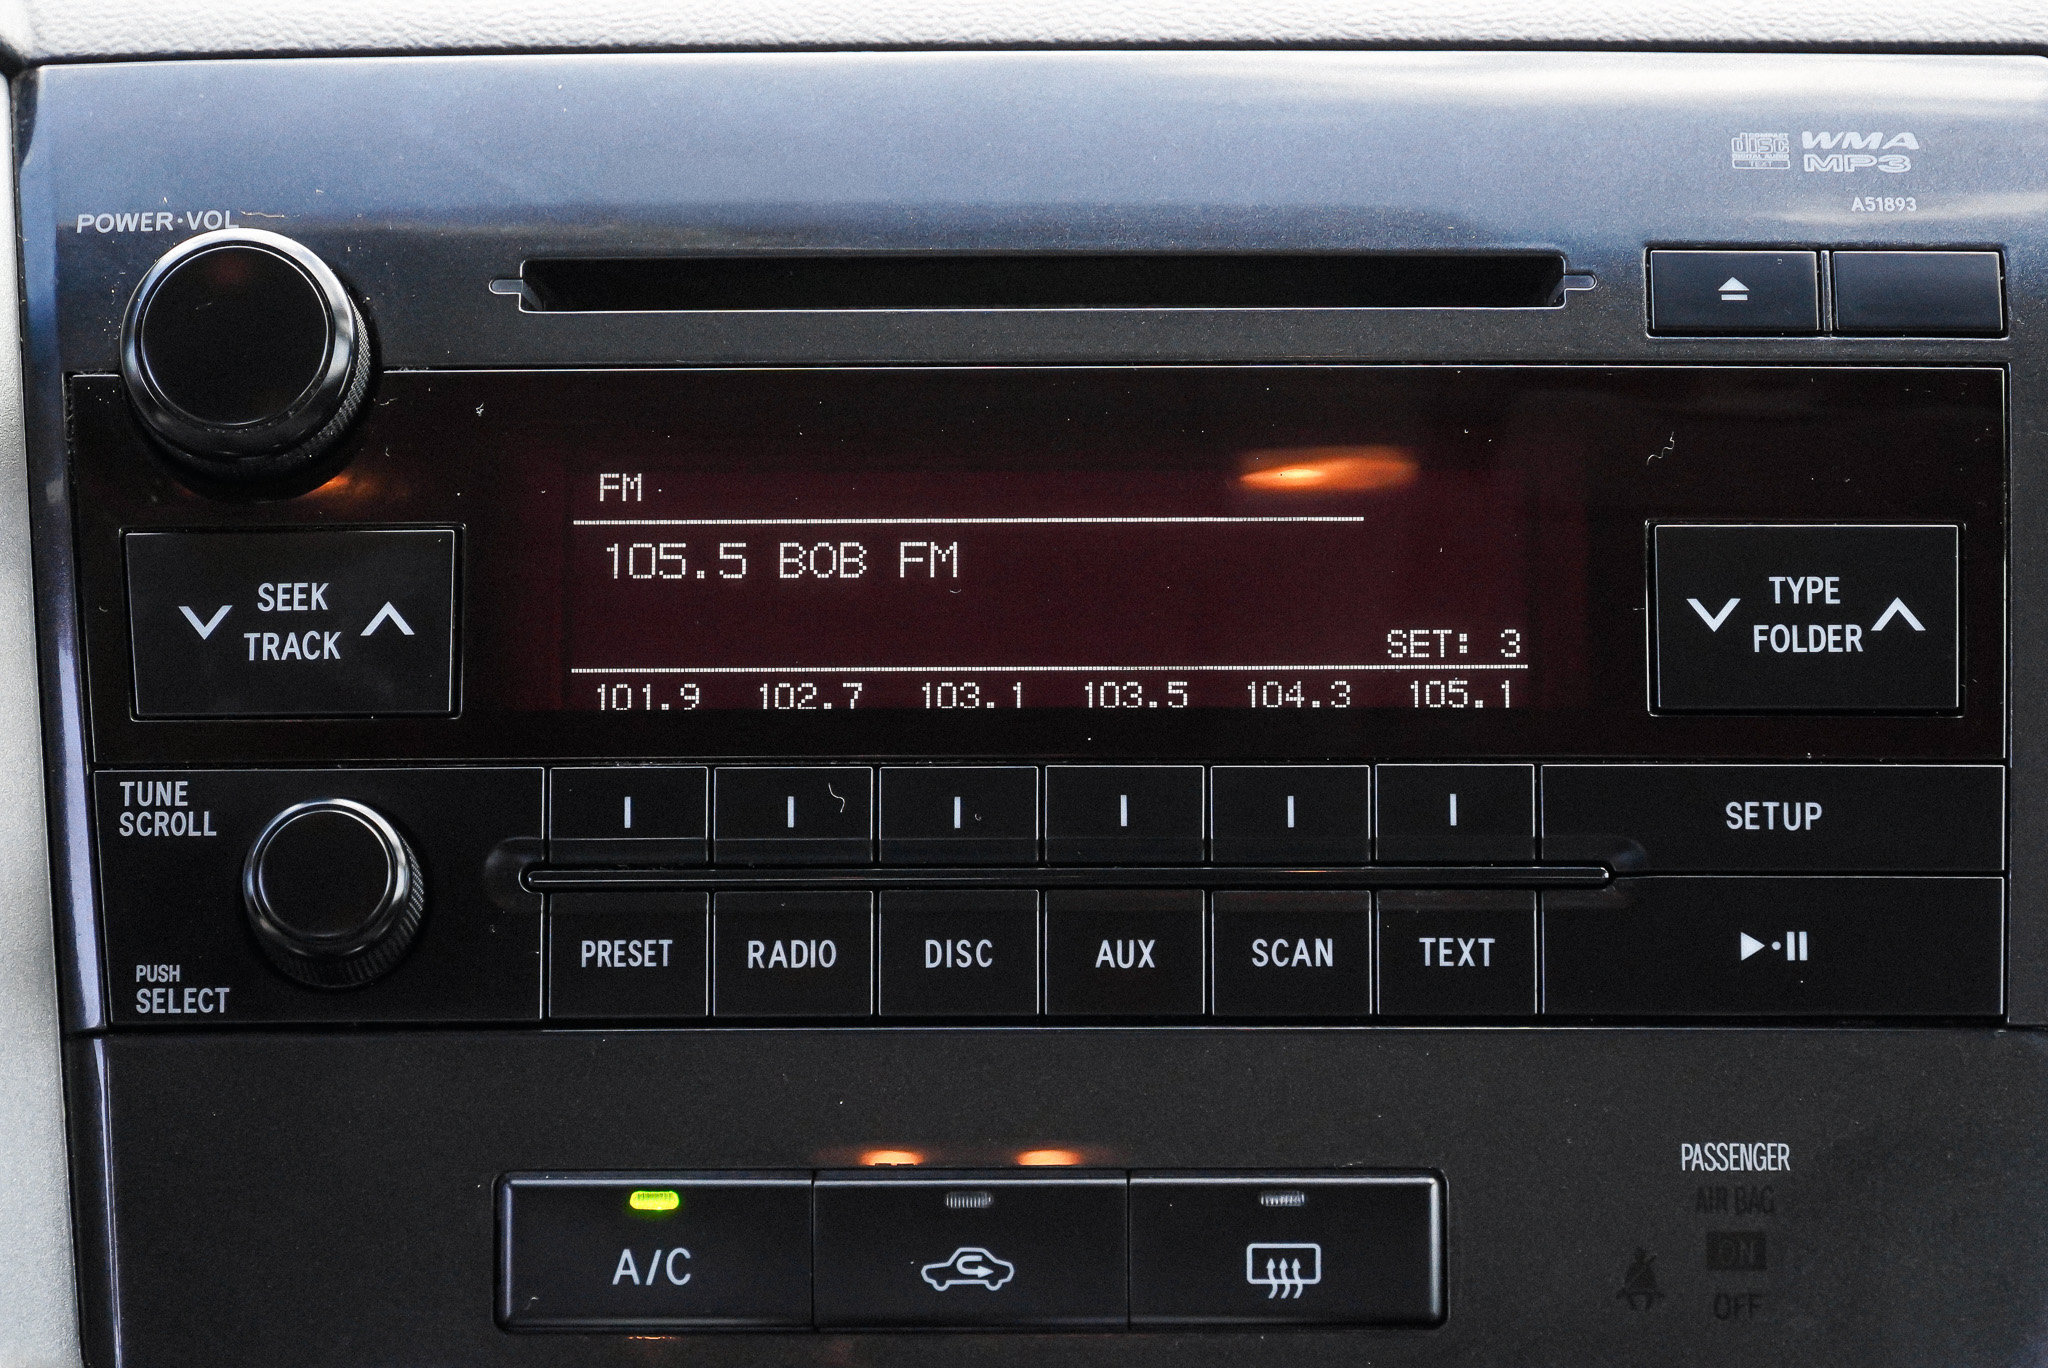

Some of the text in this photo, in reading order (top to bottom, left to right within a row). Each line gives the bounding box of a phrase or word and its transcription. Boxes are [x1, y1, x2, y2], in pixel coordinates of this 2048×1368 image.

[1802, 131, 1920, 150] WMA
[1803, 154, 1912, 173] MP3
[1851, 196, 1917, 213] A51893
[599, 472, 642, 502] FM
[606, 541, 958, 580] 105.5 BOB FM
[257, 582, 330, 612] SEEK
[1768, 576, 1841, 605] TYPE
[243, 630, 342, 661] TRACK
[1387, 628, 1521, 659] SET: 3
[1753, 623, 1864, 653] FOLDER
[596, 683, 700, 711] 101.9
[759, 682, 863, 710] 102.7
[921, 681, 1022, 709] 103.1
[1084, 681, 1188, 709] 103.5
[1247, 680, 1351, 709] 104.3
[1410, 679, 1510, 709] 105.1
[119, 780, 189, 807] TUNE
[119, 810, 217, 837] SCROLL
[1725, 801, 1823, 831] SETUP
[581, 939, 673, 968] PRESET
[747, 939, 837, 969] RADIO
[925, 939, 993, 969] DISC
[1095, 939, 1156, 969] AUX
[1251, 938, 1333, 968] SCAN
[1418, 937, 1496, 967] TEXT
[135, 964, 180, 983] PUSH
[135, 987, 230, 1014] SELECT
[1681, 1142, 1791, 1172] PASSENGER
[1697, 1186, 1776, 1214] AIR BAG
[1718, 1238, 1756, 1264] ON
[612, 1247, 691, 1286] A/C
[1713, 1294, 1762, 1320] OFF
